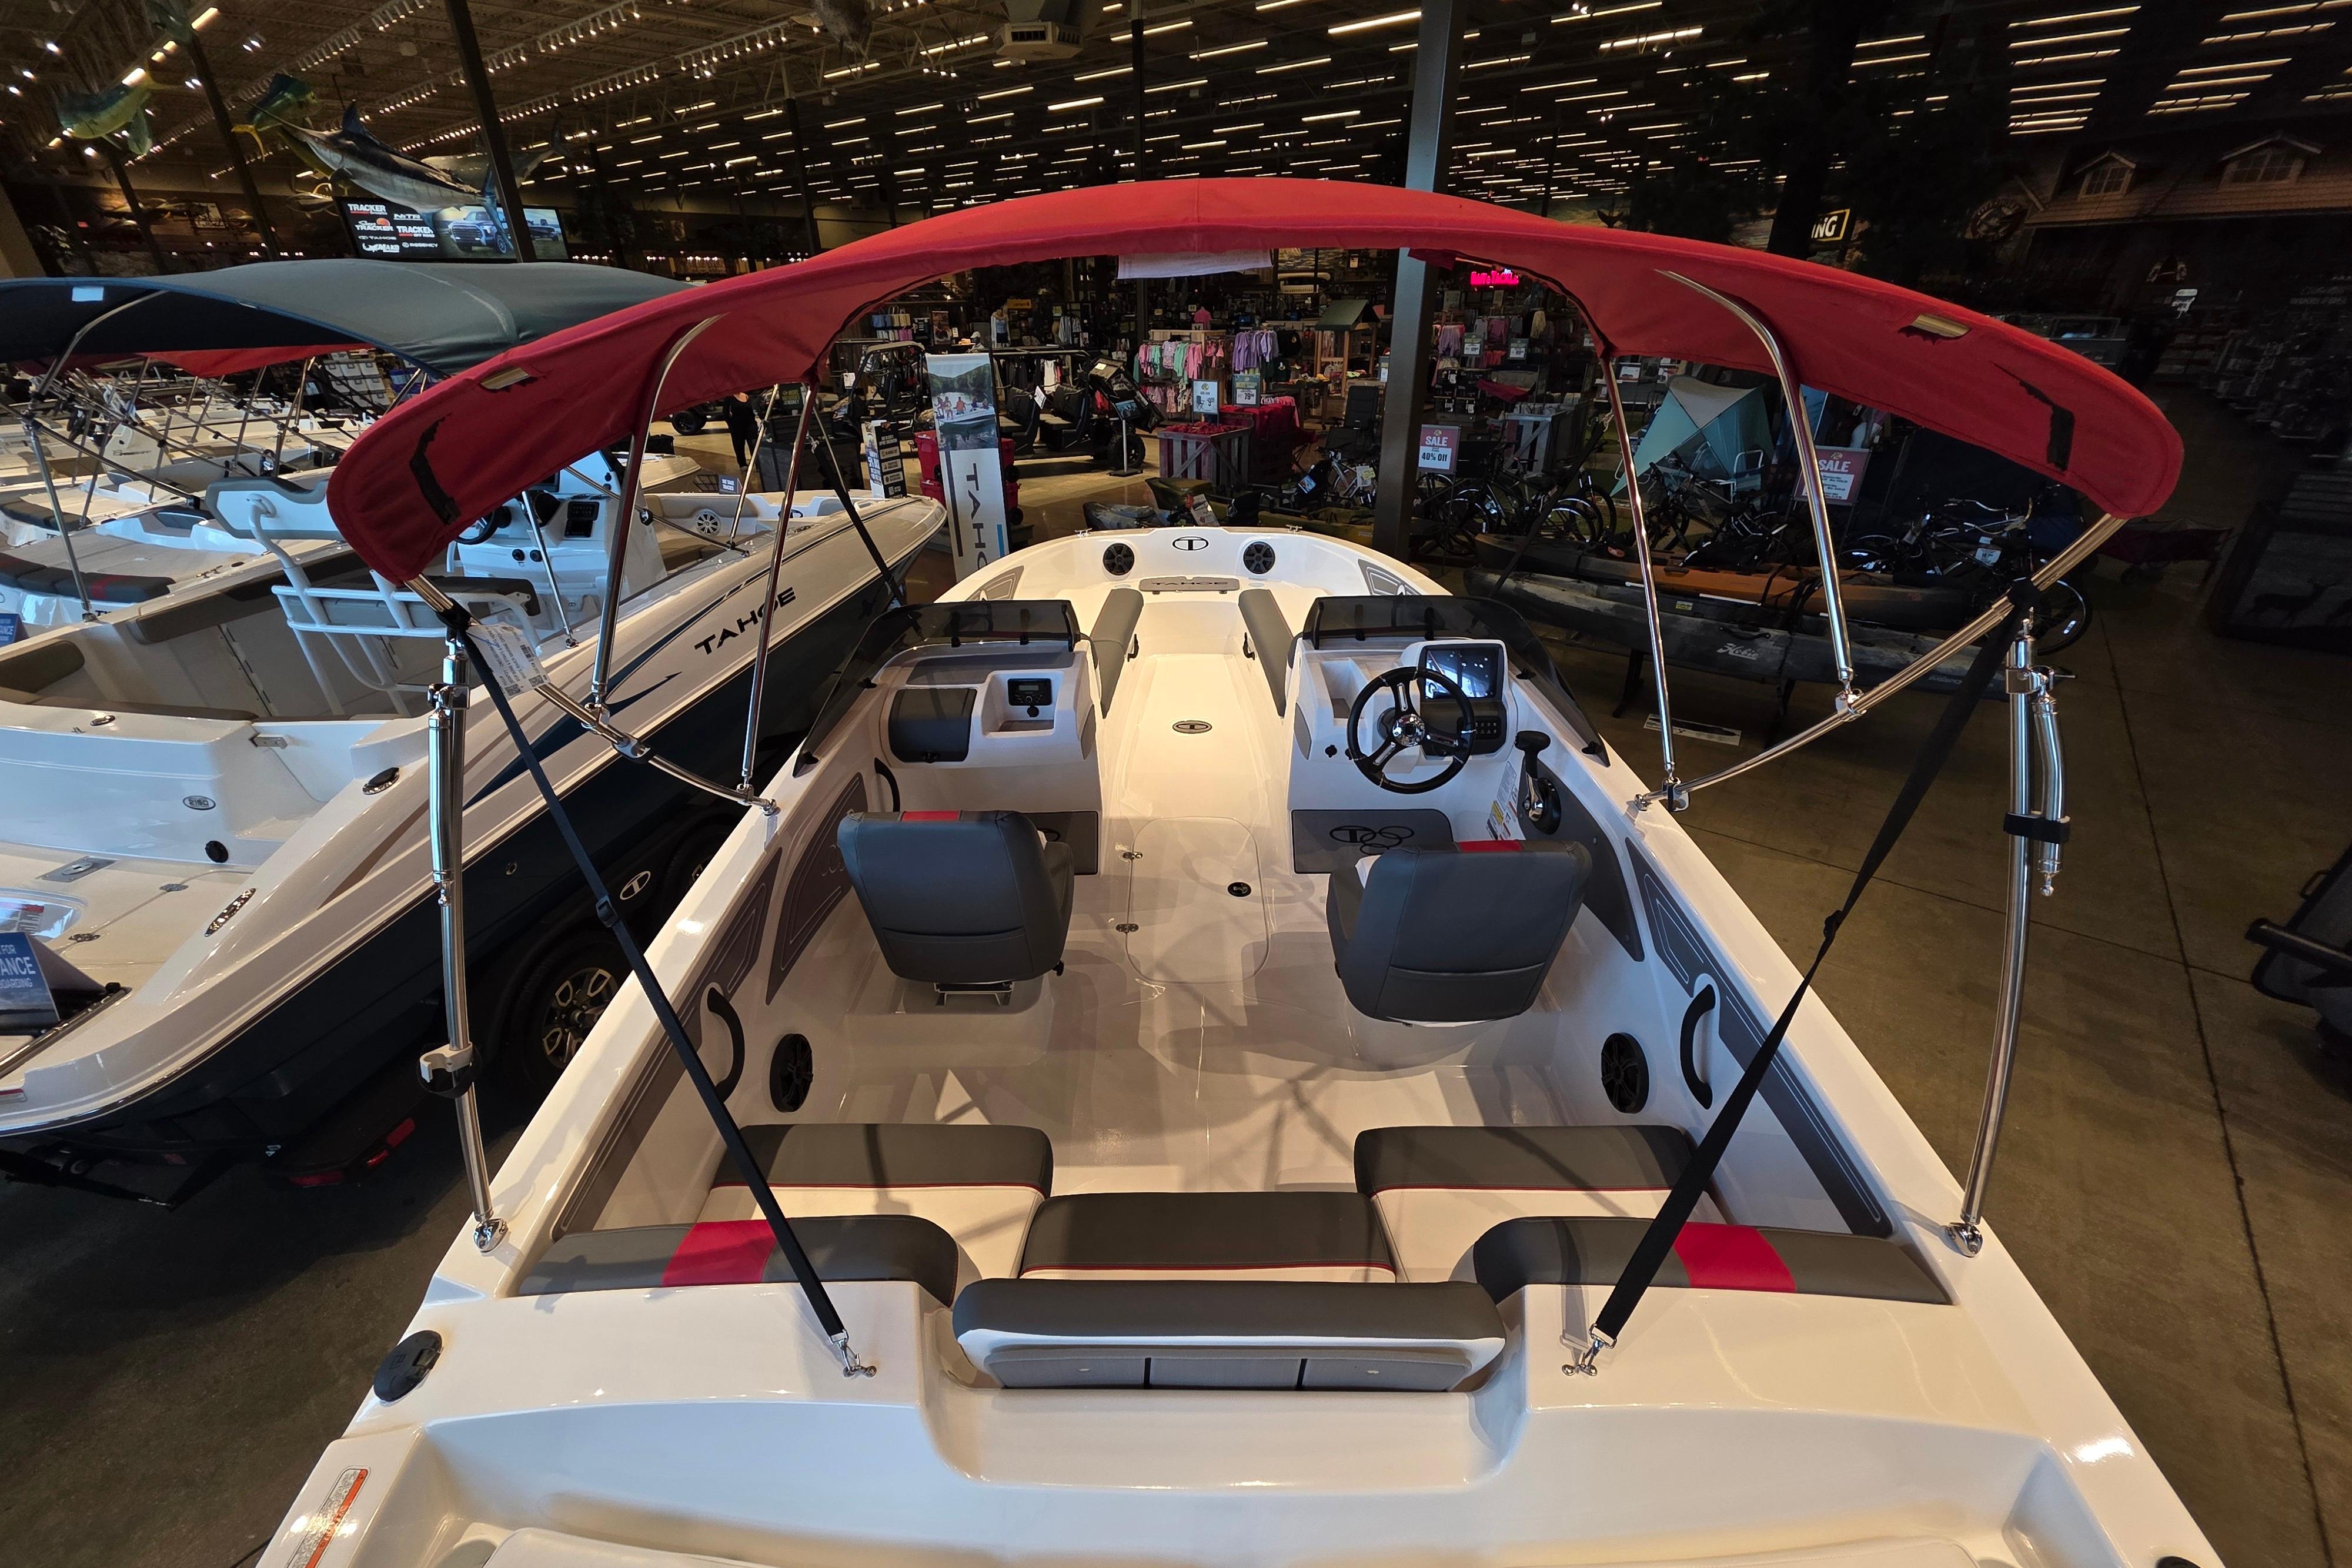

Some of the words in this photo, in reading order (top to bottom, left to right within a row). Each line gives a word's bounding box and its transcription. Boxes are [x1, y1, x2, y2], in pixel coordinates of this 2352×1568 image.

[348, 203, 386, 212] TRACKER
[1425, 436, 1448, 446] SALE
[1819, 460, 1851, 472] SALE
[966, 463, 988, 570] TAHO
[2, 945, 16, 954] FOR
